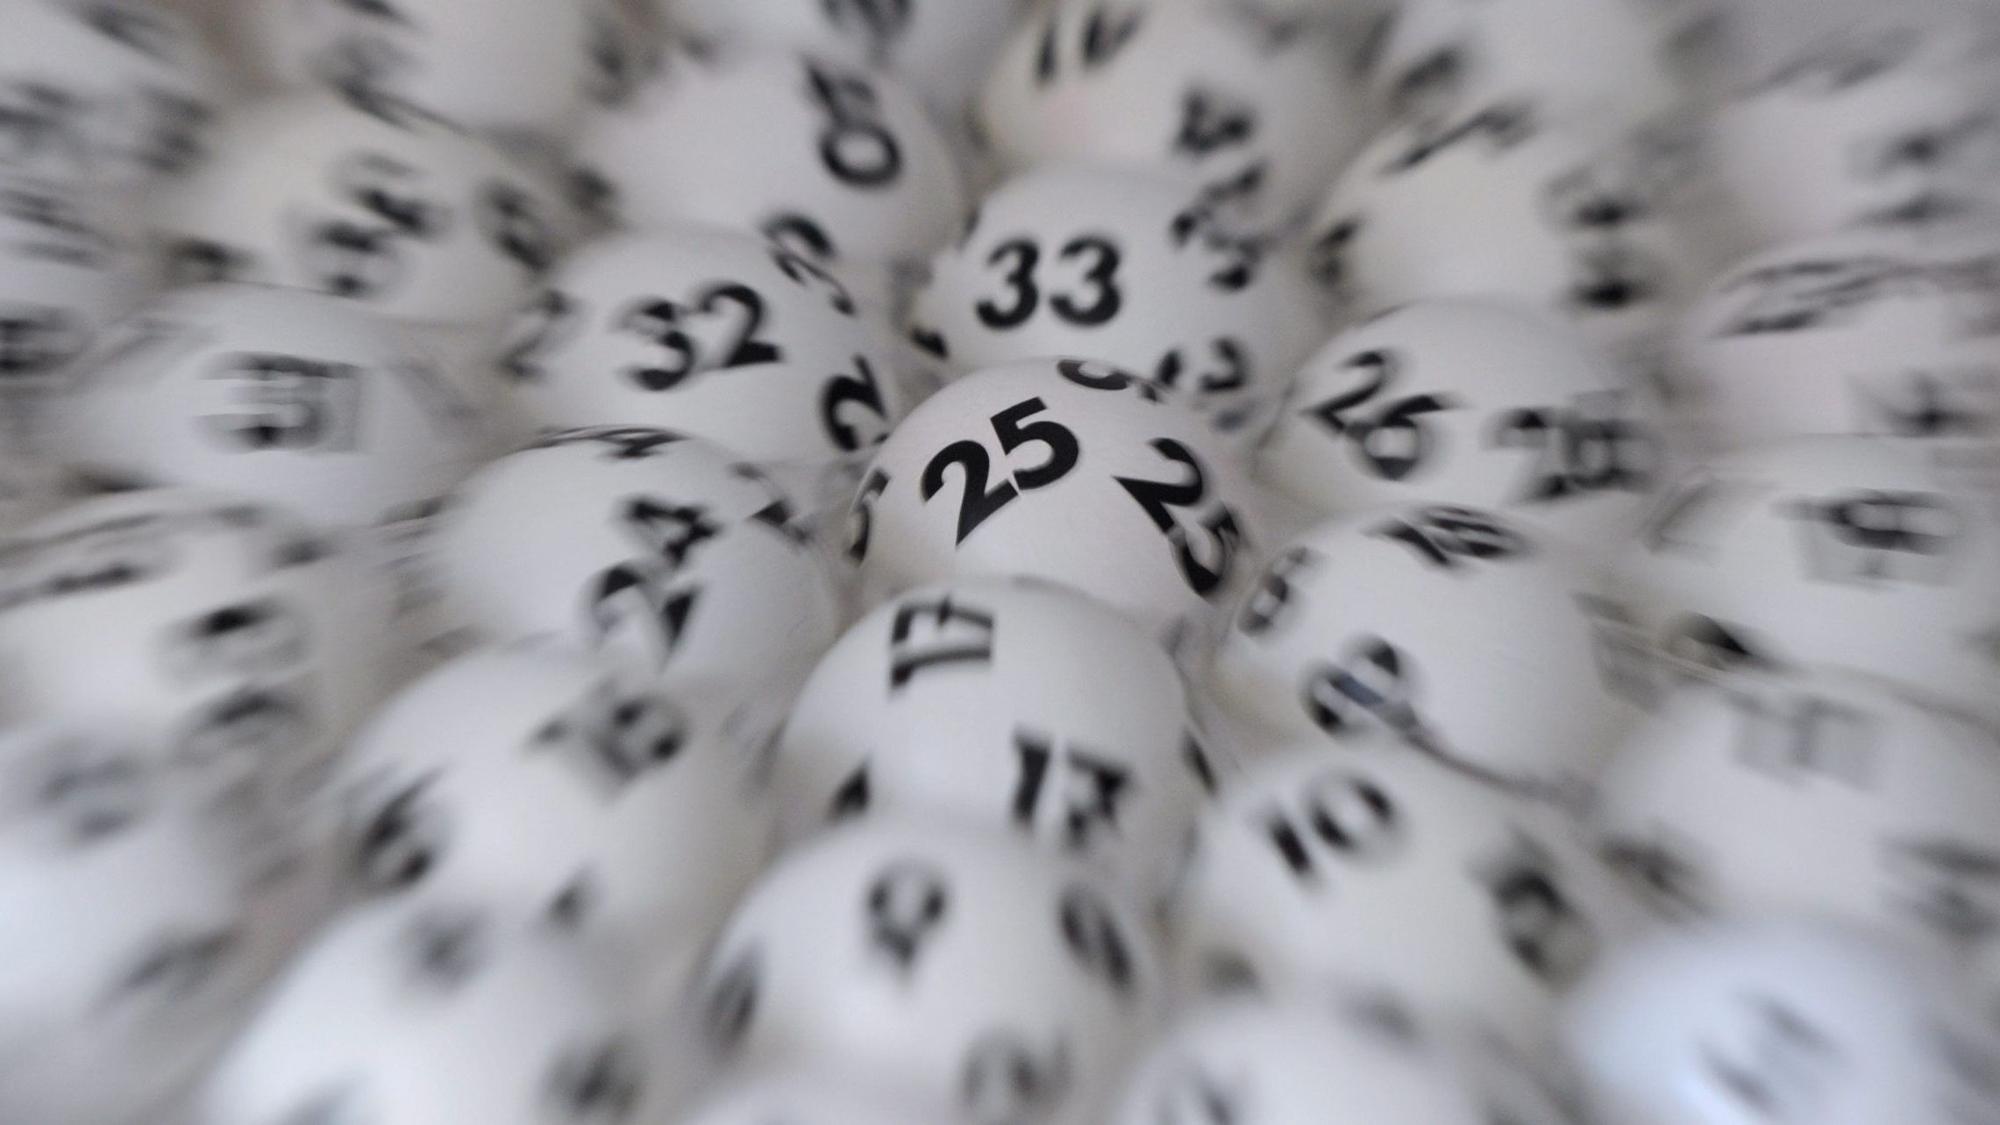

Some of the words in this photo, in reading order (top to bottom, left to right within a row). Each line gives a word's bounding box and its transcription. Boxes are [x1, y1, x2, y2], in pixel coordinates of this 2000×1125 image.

[625, 282, 783, 392] 32
[975, 234, 1120, 328] 33
[921, 397, 1079, 546] 25
[1304, 350, 1452, 480] 26
[1112, 437, 1240, 597] 25
[890, 597, 993, 692] 17
